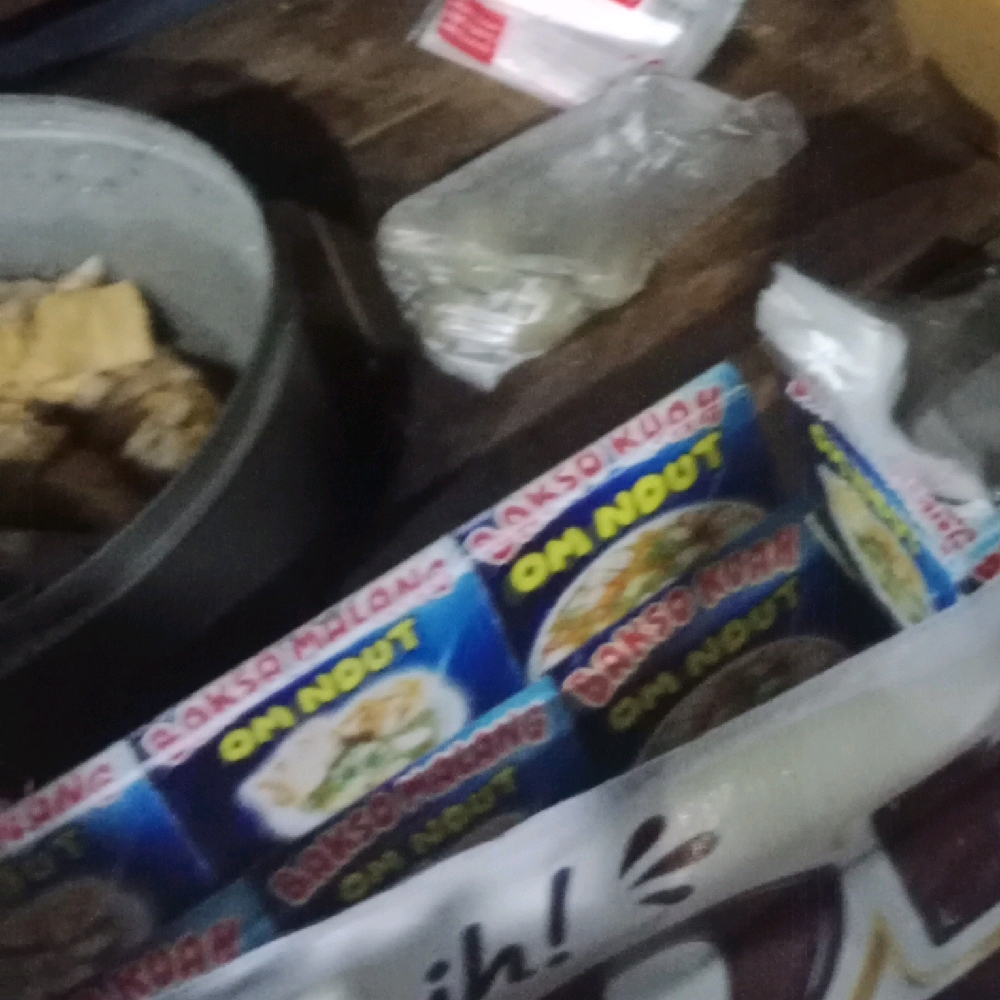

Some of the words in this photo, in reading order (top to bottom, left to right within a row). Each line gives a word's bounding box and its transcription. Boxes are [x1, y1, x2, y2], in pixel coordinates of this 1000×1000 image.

[511, 528, 593, 595] OM
[562, 588, 695, 709] BAKSO
[608, 673, 678, 733] OM
[218, 706, 295, 765] OM
[338, 846, 401, 901] OM
